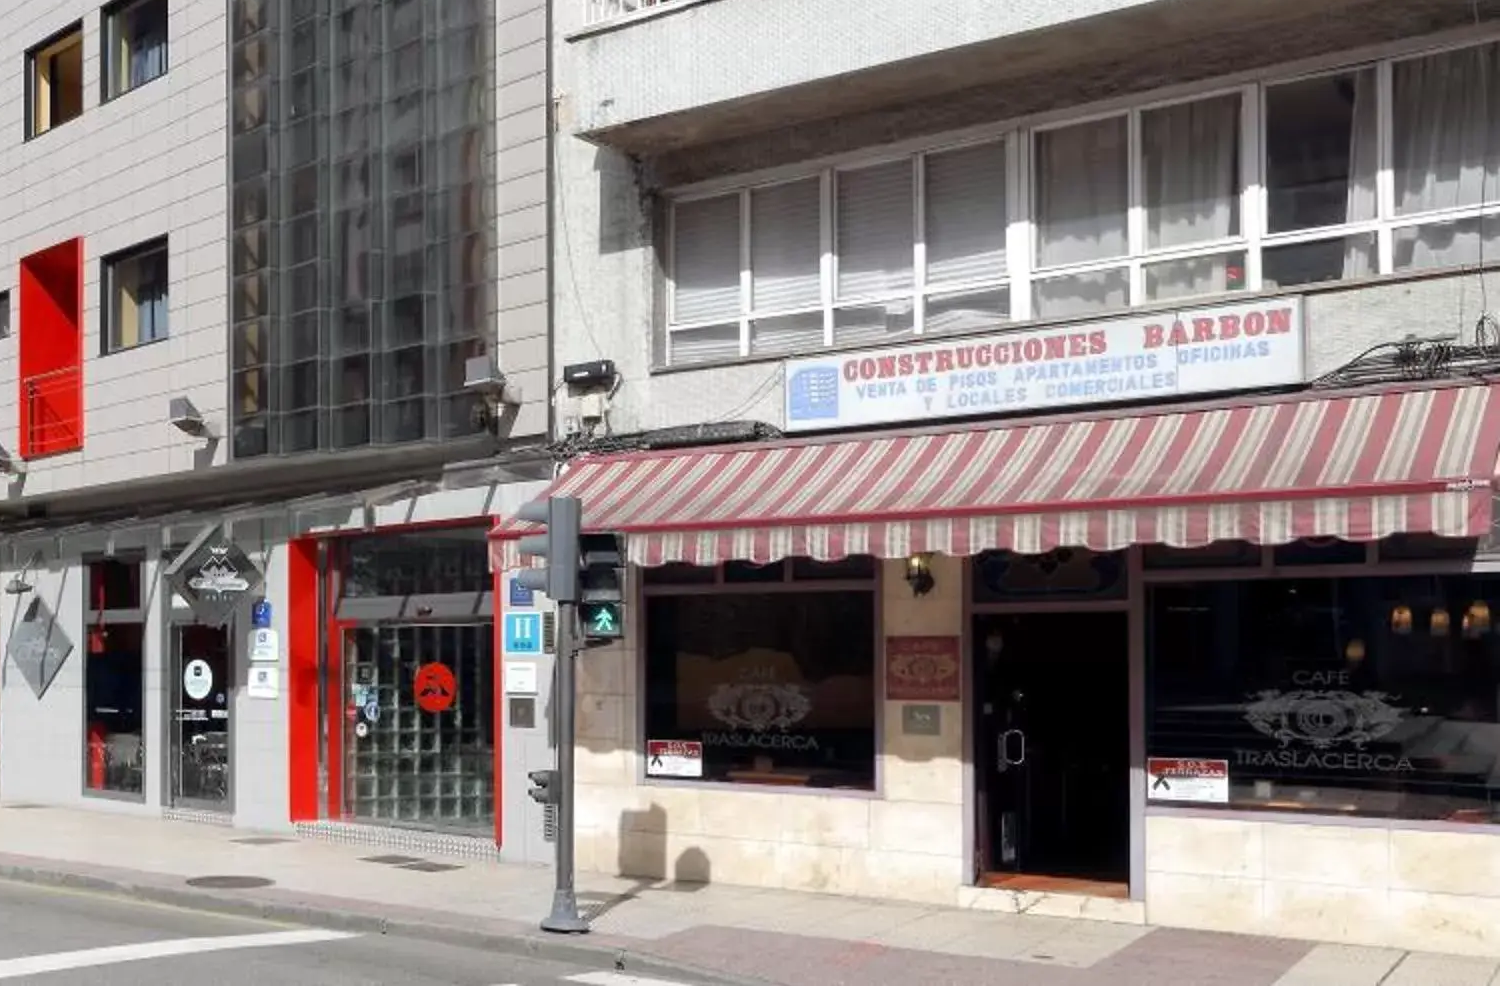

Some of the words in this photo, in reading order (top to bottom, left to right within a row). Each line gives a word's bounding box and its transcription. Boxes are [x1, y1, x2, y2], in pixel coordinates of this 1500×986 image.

[843, 330, 1107, 382] CONSTRUCCIONES
[1142, 307, 1293, 349] BARBON
[856, 380, 907, 399] VENTA
[916, 377, 937, 393] DE
[949, 371, 998, 390] PISOS
[1013, 353, 1159, 382] APARTAMENTOS
[1177, 340, 1271, 365] OFICINAS
[923, 395, 933, 411] Y
[948, 387, 1028, 409] LOCALES
[1045, 371, 1176, 399] COMERCIALES
[701, 730, 820, 750] TRASLACERCA
[1235, 749, 1416, 771] TRASLACERCA
